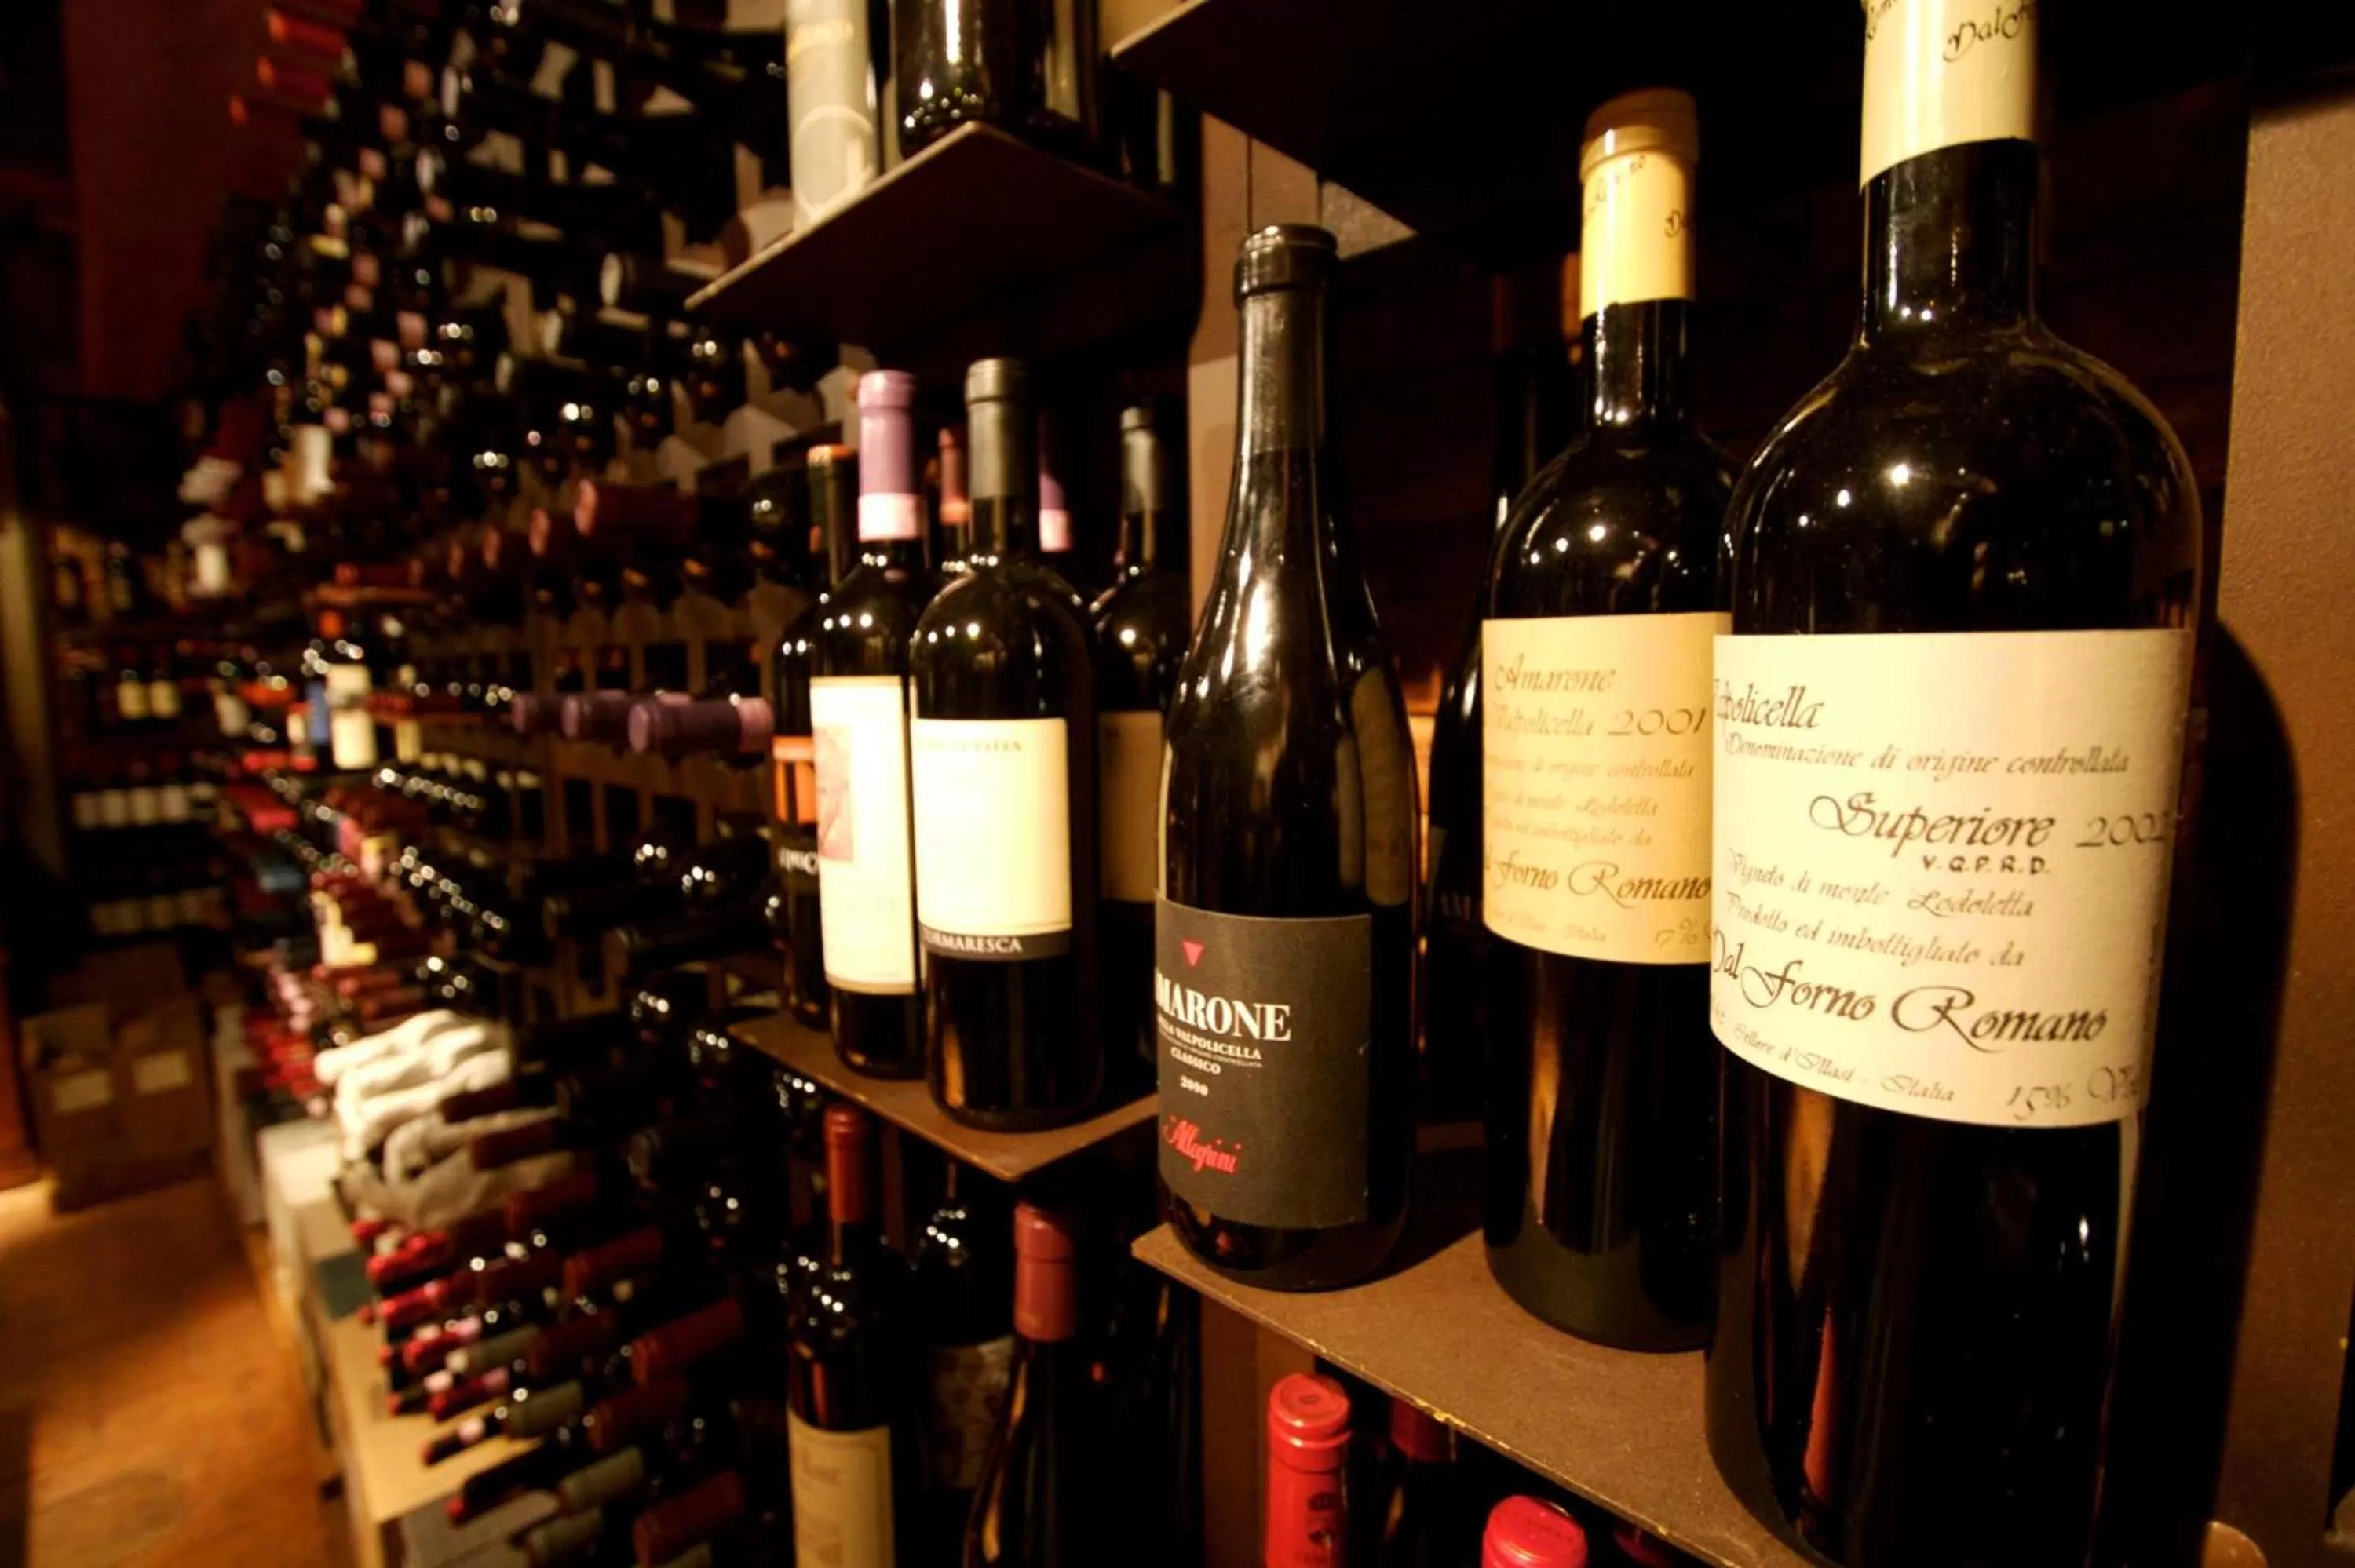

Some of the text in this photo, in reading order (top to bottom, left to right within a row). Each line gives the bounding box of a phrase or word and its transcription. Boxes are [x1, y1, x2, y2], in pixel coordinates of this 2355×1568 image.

[1494, 652, 1616, 691] Amarone
[1608, 708, 1707, 735] 2001
[1724, 731, 2130, 783] Denominazione di origine controllata
[1809, 792, 2055, 857] Superiore
[1568, 860, 1711, 910] Romano
[1907, 888, 2035, 918] Lodoletta
[1989, 940, 2025, 967] da
[1155, 967, 1291, 1041] MARONE
[1740, 960, 1876, 1022] Forno
[1891, 985, 2109, 1055] Romano
[1170, 1045, 1221, 1075] CLASSICO
[1174, 1026, 1262, 1061] VALPOLICELLA
